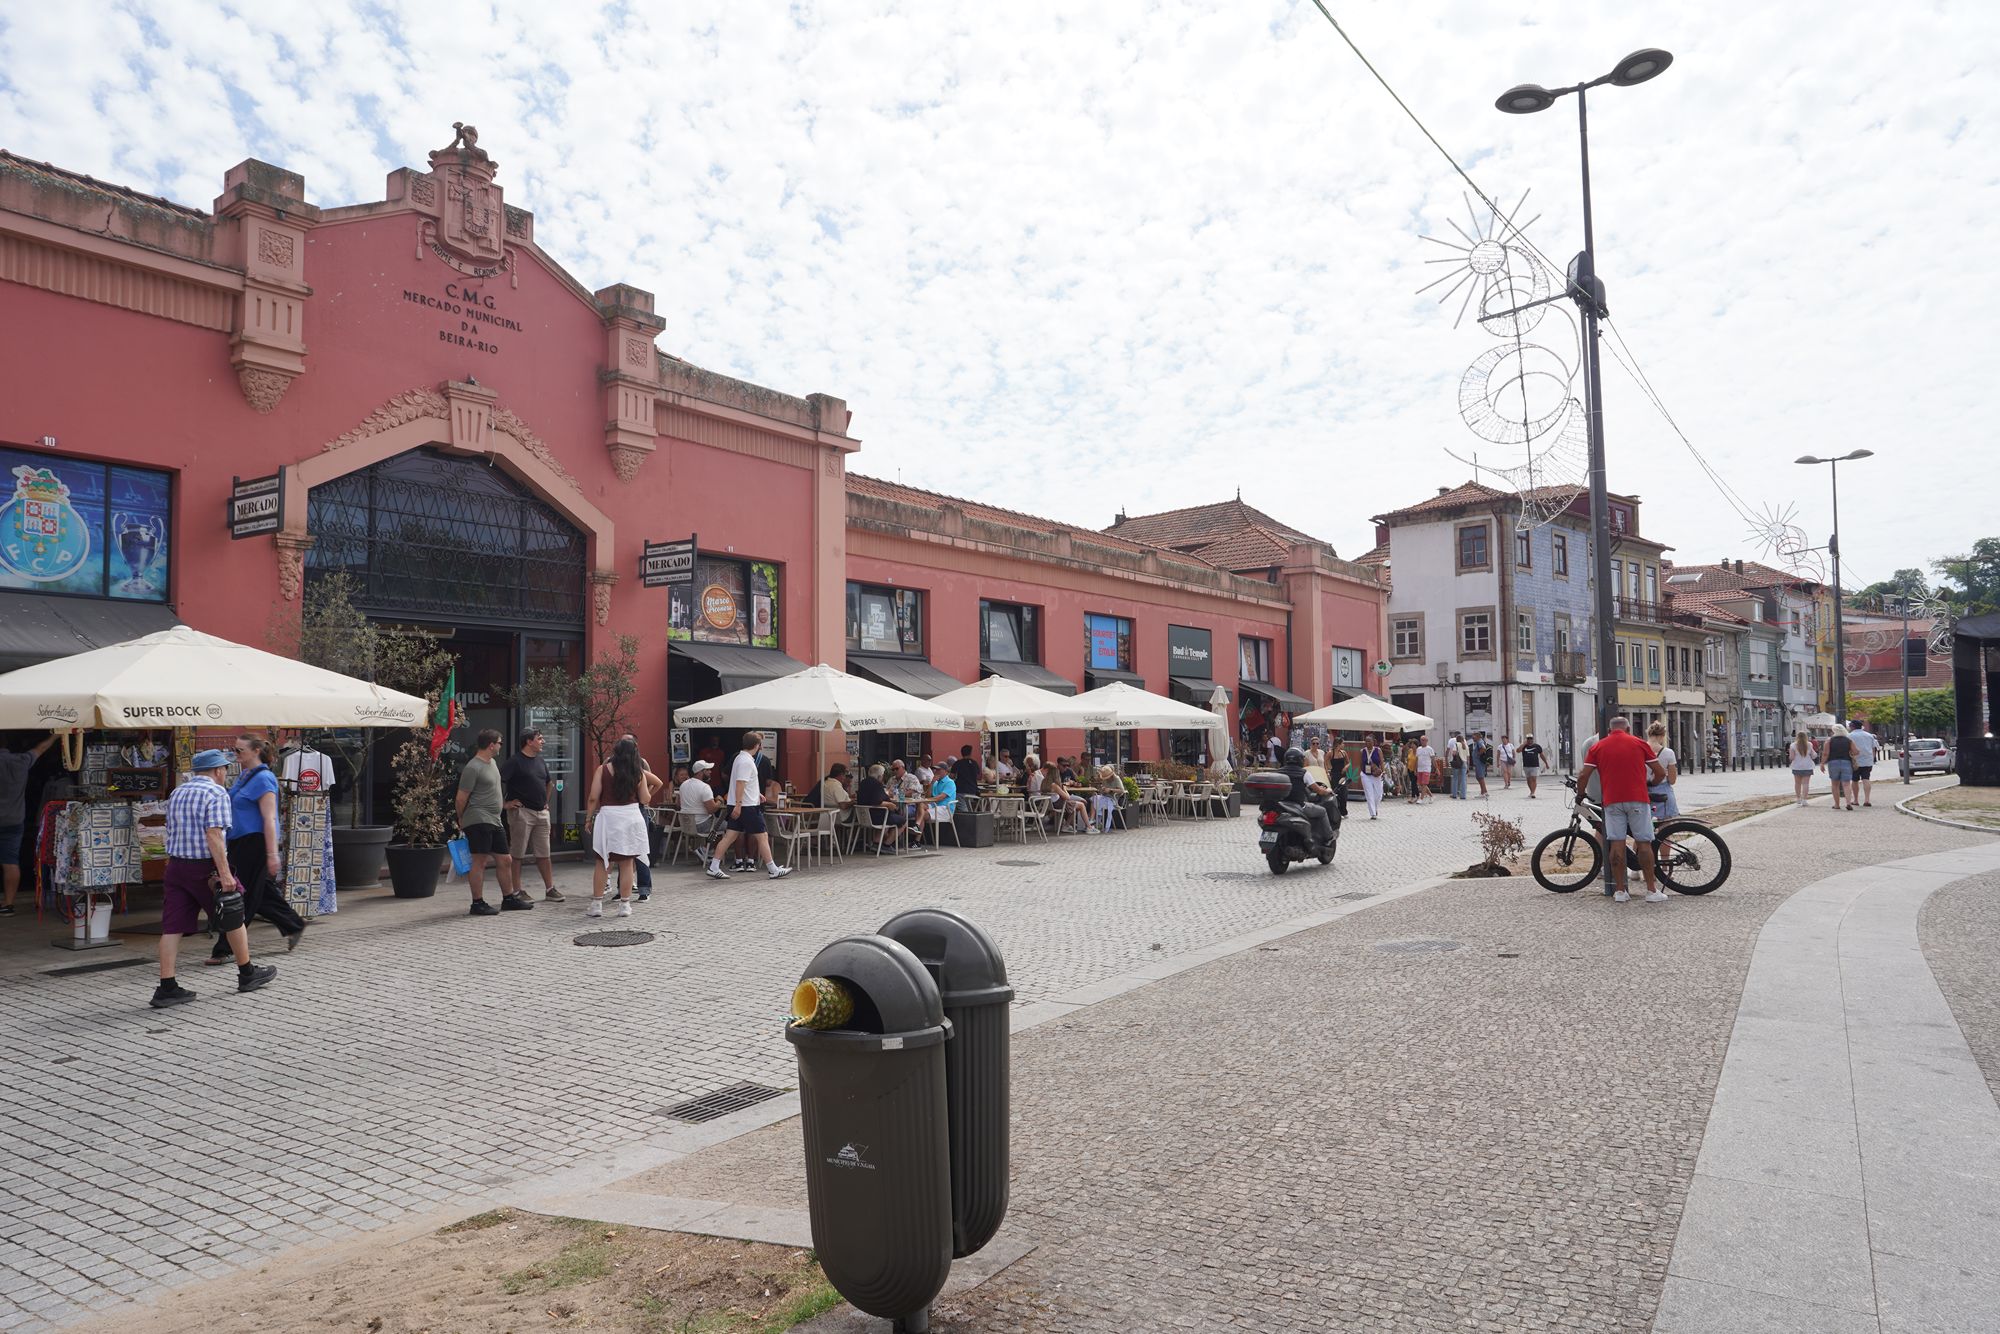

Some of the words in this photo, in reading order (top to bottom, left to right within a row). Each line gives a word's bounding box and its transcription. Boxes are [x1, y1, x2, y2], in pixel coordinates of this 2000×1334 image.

[458, 262, 463, 271] E
[403, 290, 461, 314] MERCADO
[466, 308, 523, 332] MUNICIPAL
[461, 321, 478, 334] DA
[439, 330, 499, 354] BEIRA-RIO
[43, 436, 56, 447] 10
[236, 497, 278, 516] MERCADO
[647, 556, 691, 570] MERCADO
[122, 706, 165, 718] SUPER
[166, 705, 202, 717] BOCK
[354, 705, 379, 716] Sabor
[681, 716, 698, 724] SUPER
[850, 719, 864, 727] SUPER
[674, 732, 688, 744] 8€
